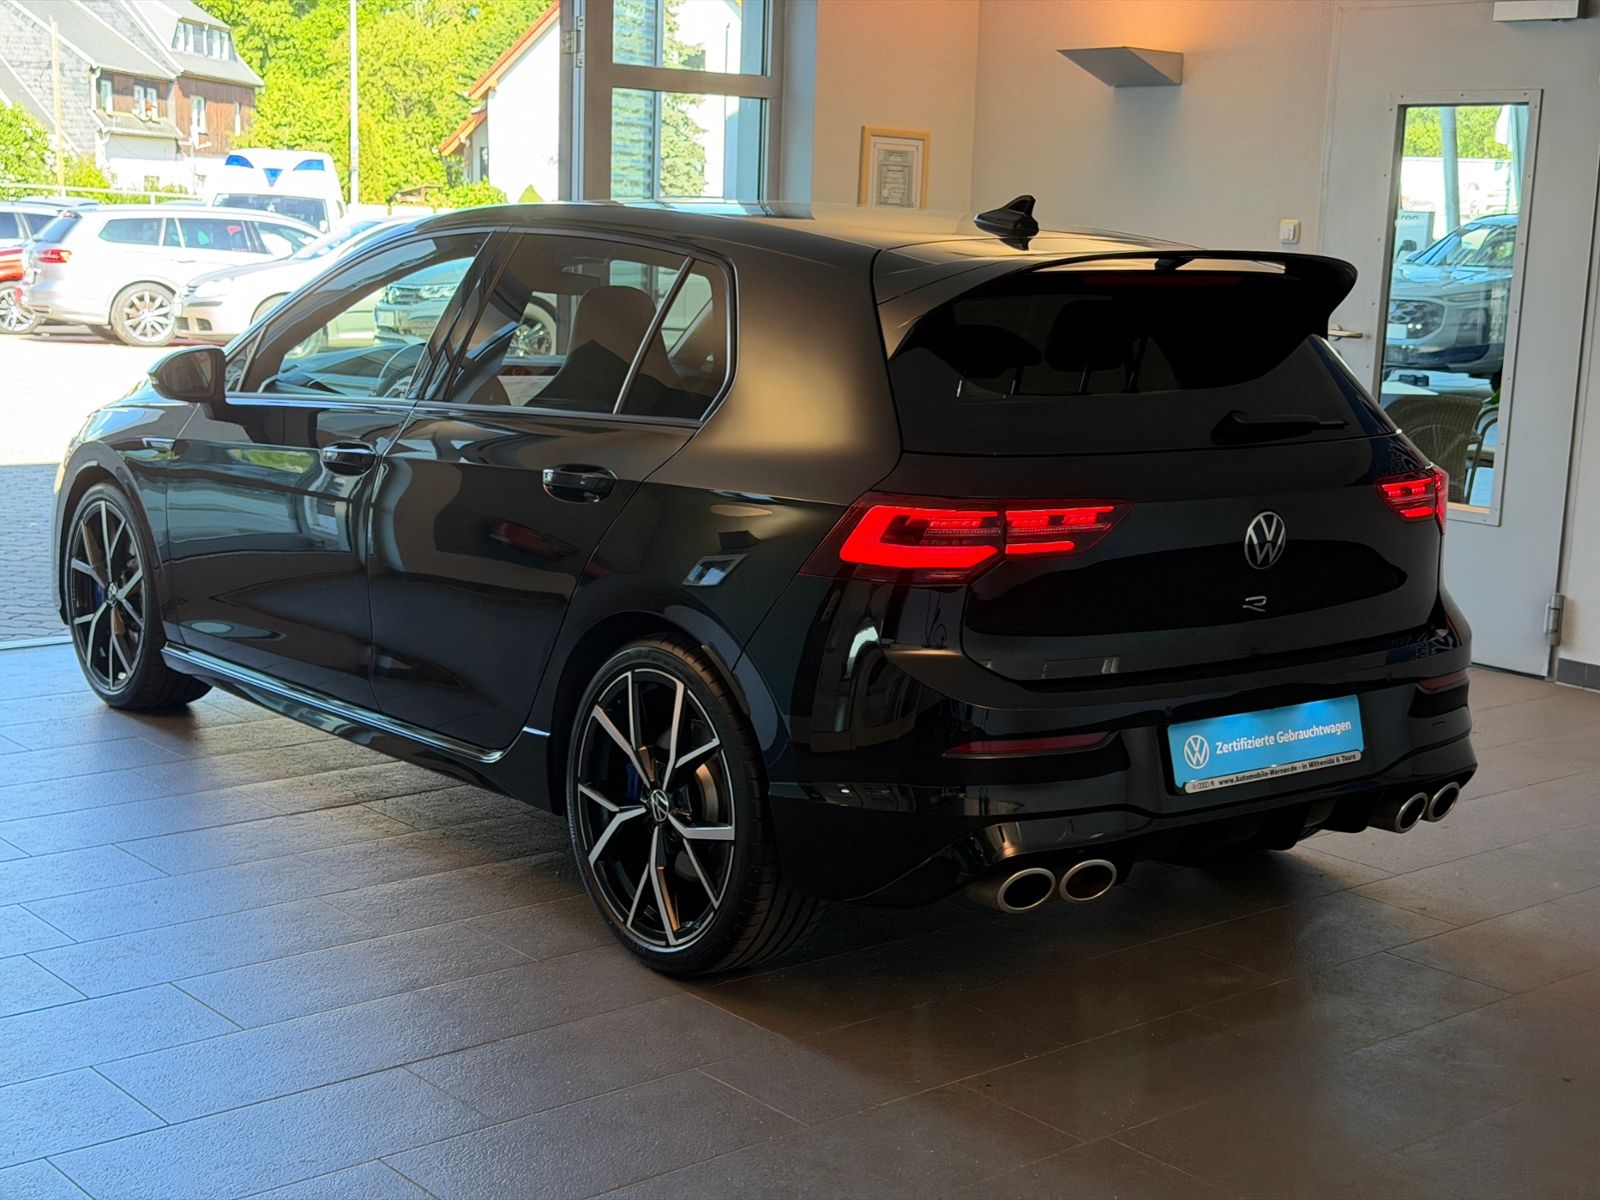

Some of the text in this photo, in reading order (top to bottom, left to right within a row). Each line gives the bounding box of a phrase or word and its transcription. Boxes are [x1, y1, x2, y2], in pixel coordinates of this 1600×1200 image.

[1244, 511, 1286, 570] VW
[1184, 734, 1210, 769] VW
[1215, 721, 1352, 754] Zertifizierte Gebrauchtwagen
